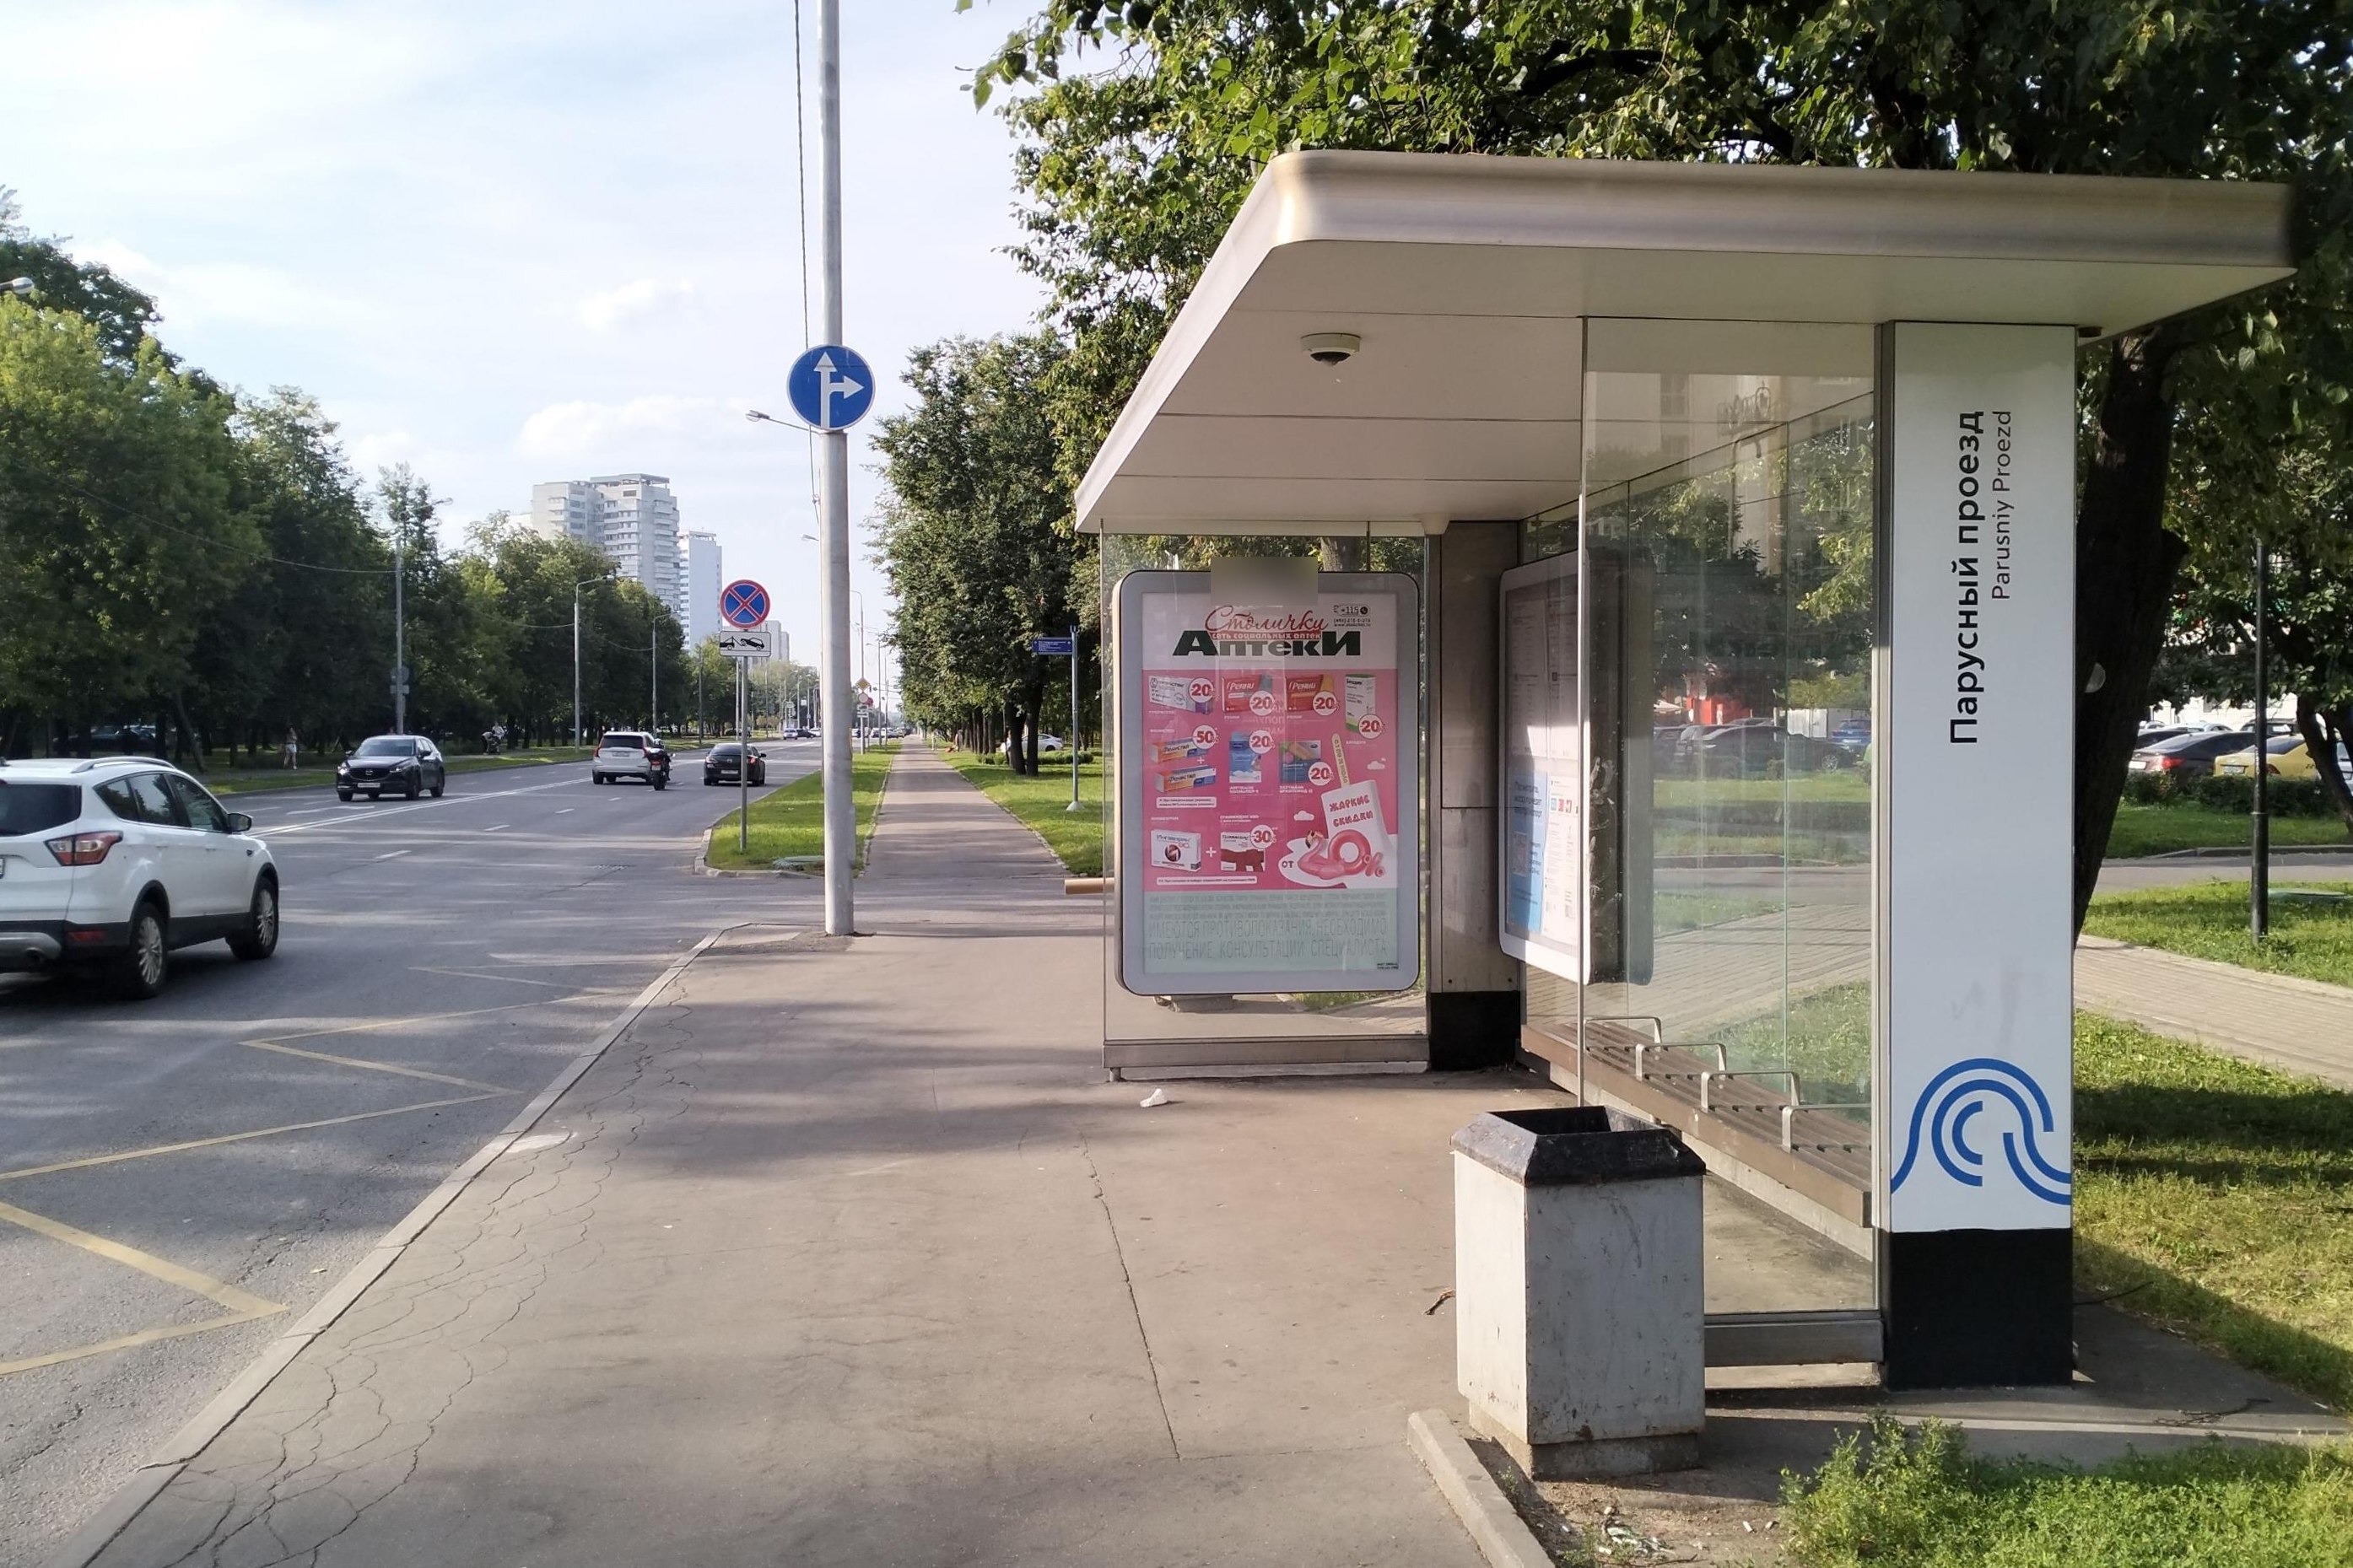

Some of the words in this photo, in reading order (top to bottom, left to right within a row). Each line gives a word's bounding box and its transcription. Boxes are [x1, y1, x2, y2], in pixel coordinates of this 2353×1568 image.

[1958, 411, 1986, 544] проезд
[1992, 410, 2012, 492] Proezd
[1992, 499, 2015, 600] Parusniy
[1205, 605, 1329, 632] Столички
[1950, 558, 1985, 744] Парусный
[1332, 811, 1373, 827] СКИДКИ
[1149, 940, 1213, 959] ПОЛУЧЕНИЕ
[1220, 939, 1304, 958] КОНСУЛЬТАЦИИ
[1311, 937, 1388, 957] СПЕЦИАЛИСТА
